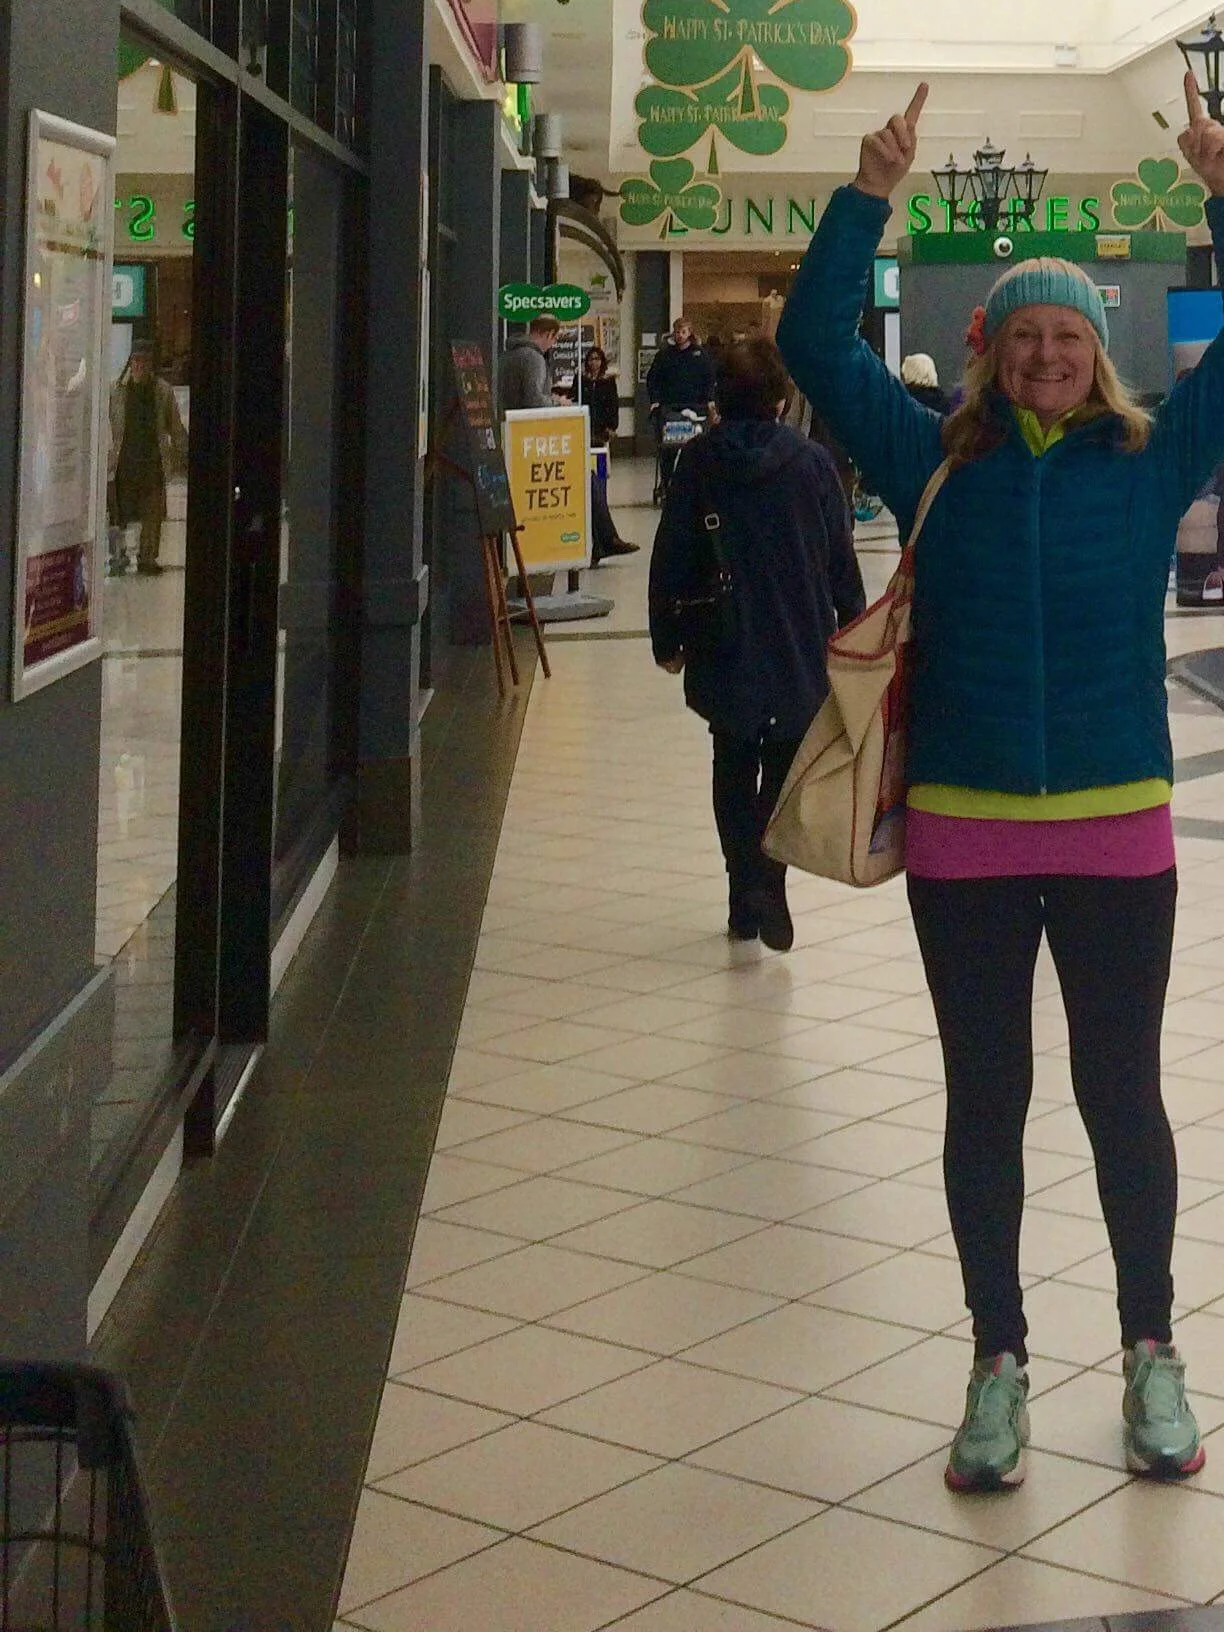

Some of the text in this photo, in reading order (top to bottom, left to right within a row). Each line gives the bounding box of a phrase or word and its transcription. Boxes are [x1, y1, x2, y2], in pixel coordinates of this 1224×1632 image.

[663, 16, 707, 40] HAPPY
[737, 19, 807, 44] PATRICK'S
[808, 21, 840, 46] DAY
[503, 292, 582, 314] Specsavers
[522, 435, 573, 458] FREE
[530, 461, 566, 483] EYE
[525, 486, 571, 511] TEST
